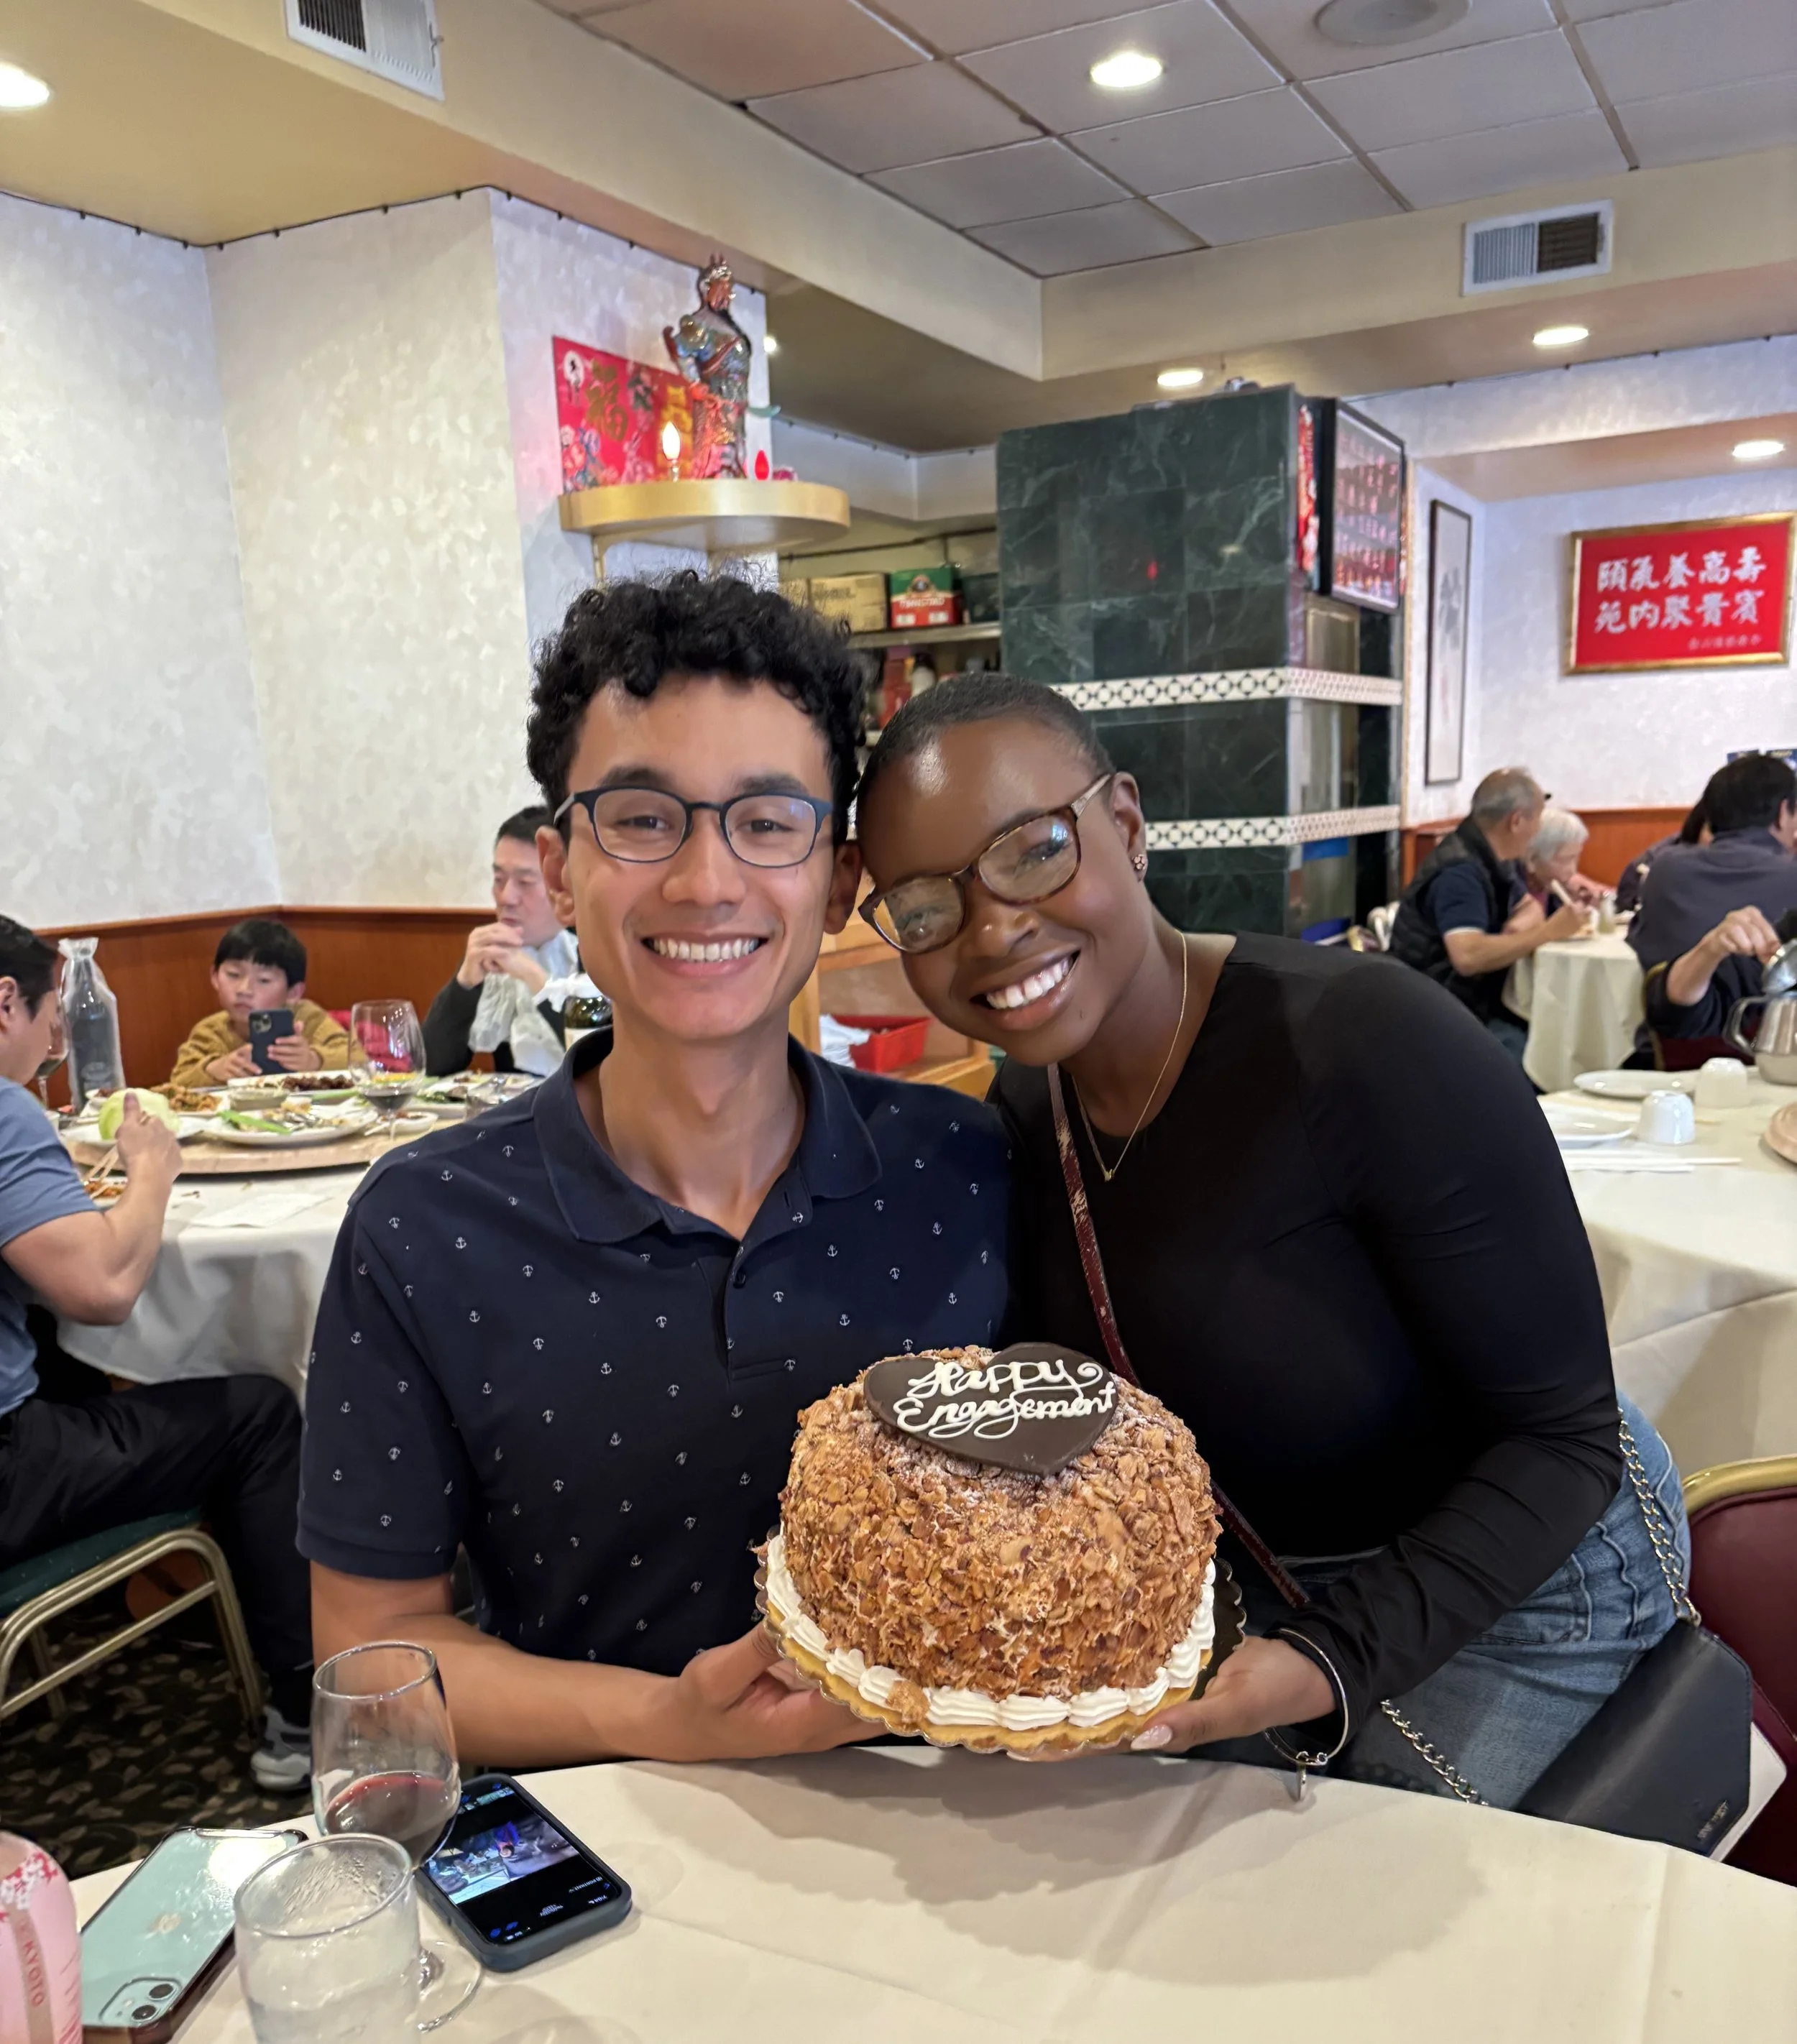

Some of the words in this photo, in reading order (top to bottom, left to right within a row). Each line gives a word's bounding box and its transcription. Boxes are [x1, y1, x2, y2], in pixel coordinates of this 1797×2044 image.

[586, 359, 628, 441] 福
[893, 1381, 1117, 1440] Engagement
[906, 1359, 1103, 1401] Happy
[24, 1941, 45, 2007] KYOTO
